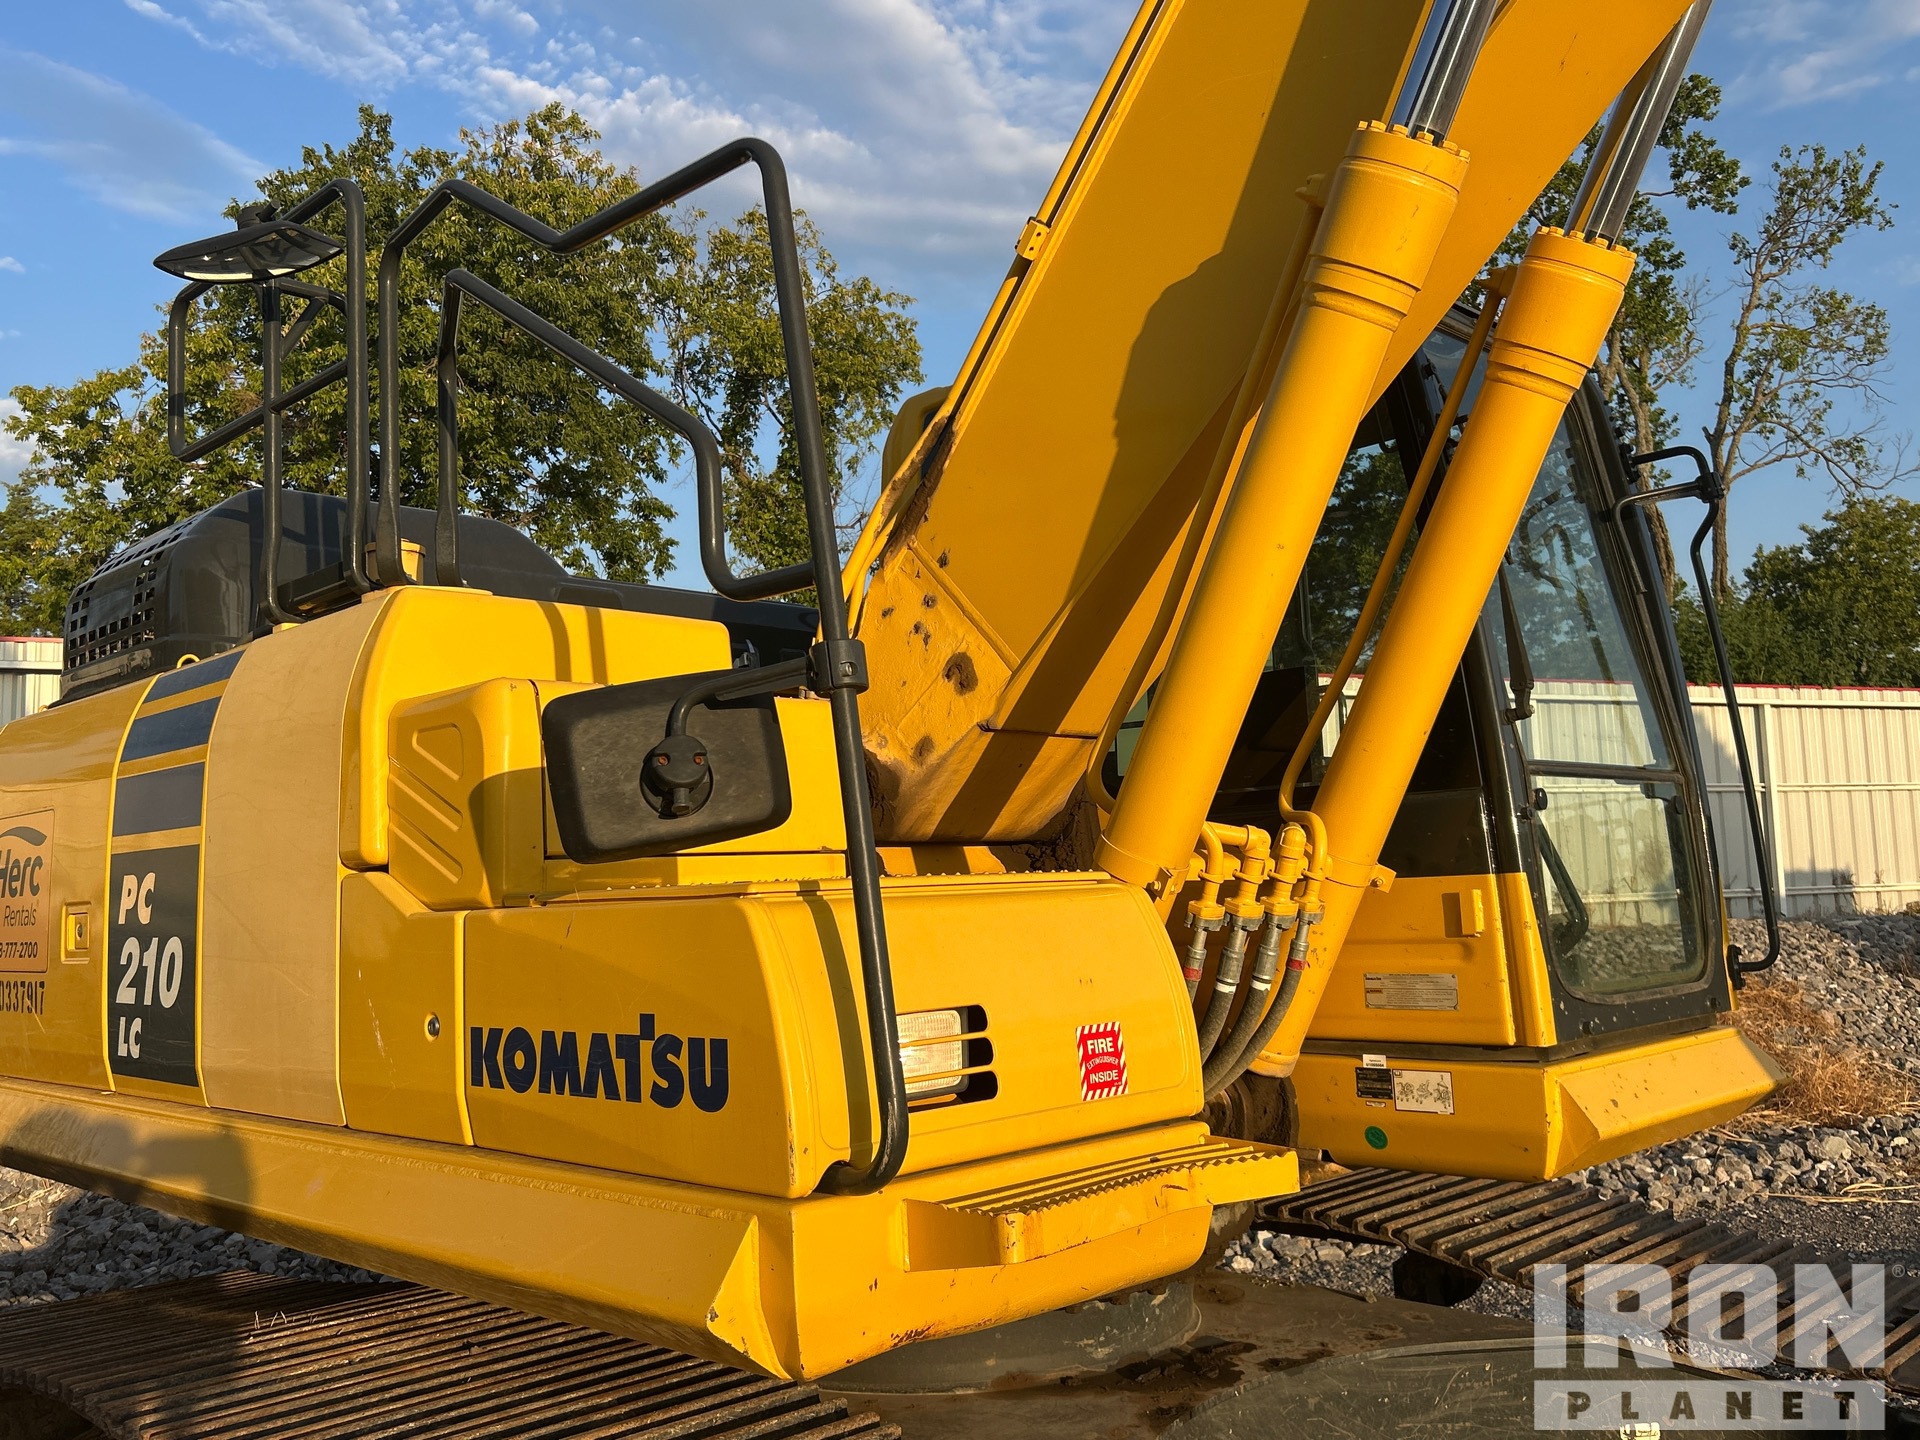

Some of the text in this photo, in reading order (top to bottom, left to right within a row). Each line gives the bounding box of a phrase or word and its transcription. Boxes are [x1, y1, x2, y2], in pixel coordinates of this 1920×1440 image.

[0, 849, 43, 898] Herc
[3, 903, 37, 927] Rentals
[118, 872, 156, 925] PC
[115, 936, 183, 1008] 210
[117, 1016, 142, 1059] LC
[1087, 1037, 1114, 1054] FIRE
[470, 1013, 729, 1113] KOMATSU
[1086, 1055, 1119, 1070] EXTINGUISHER
[1089, 1069, 1119, 1084] INSIDE
